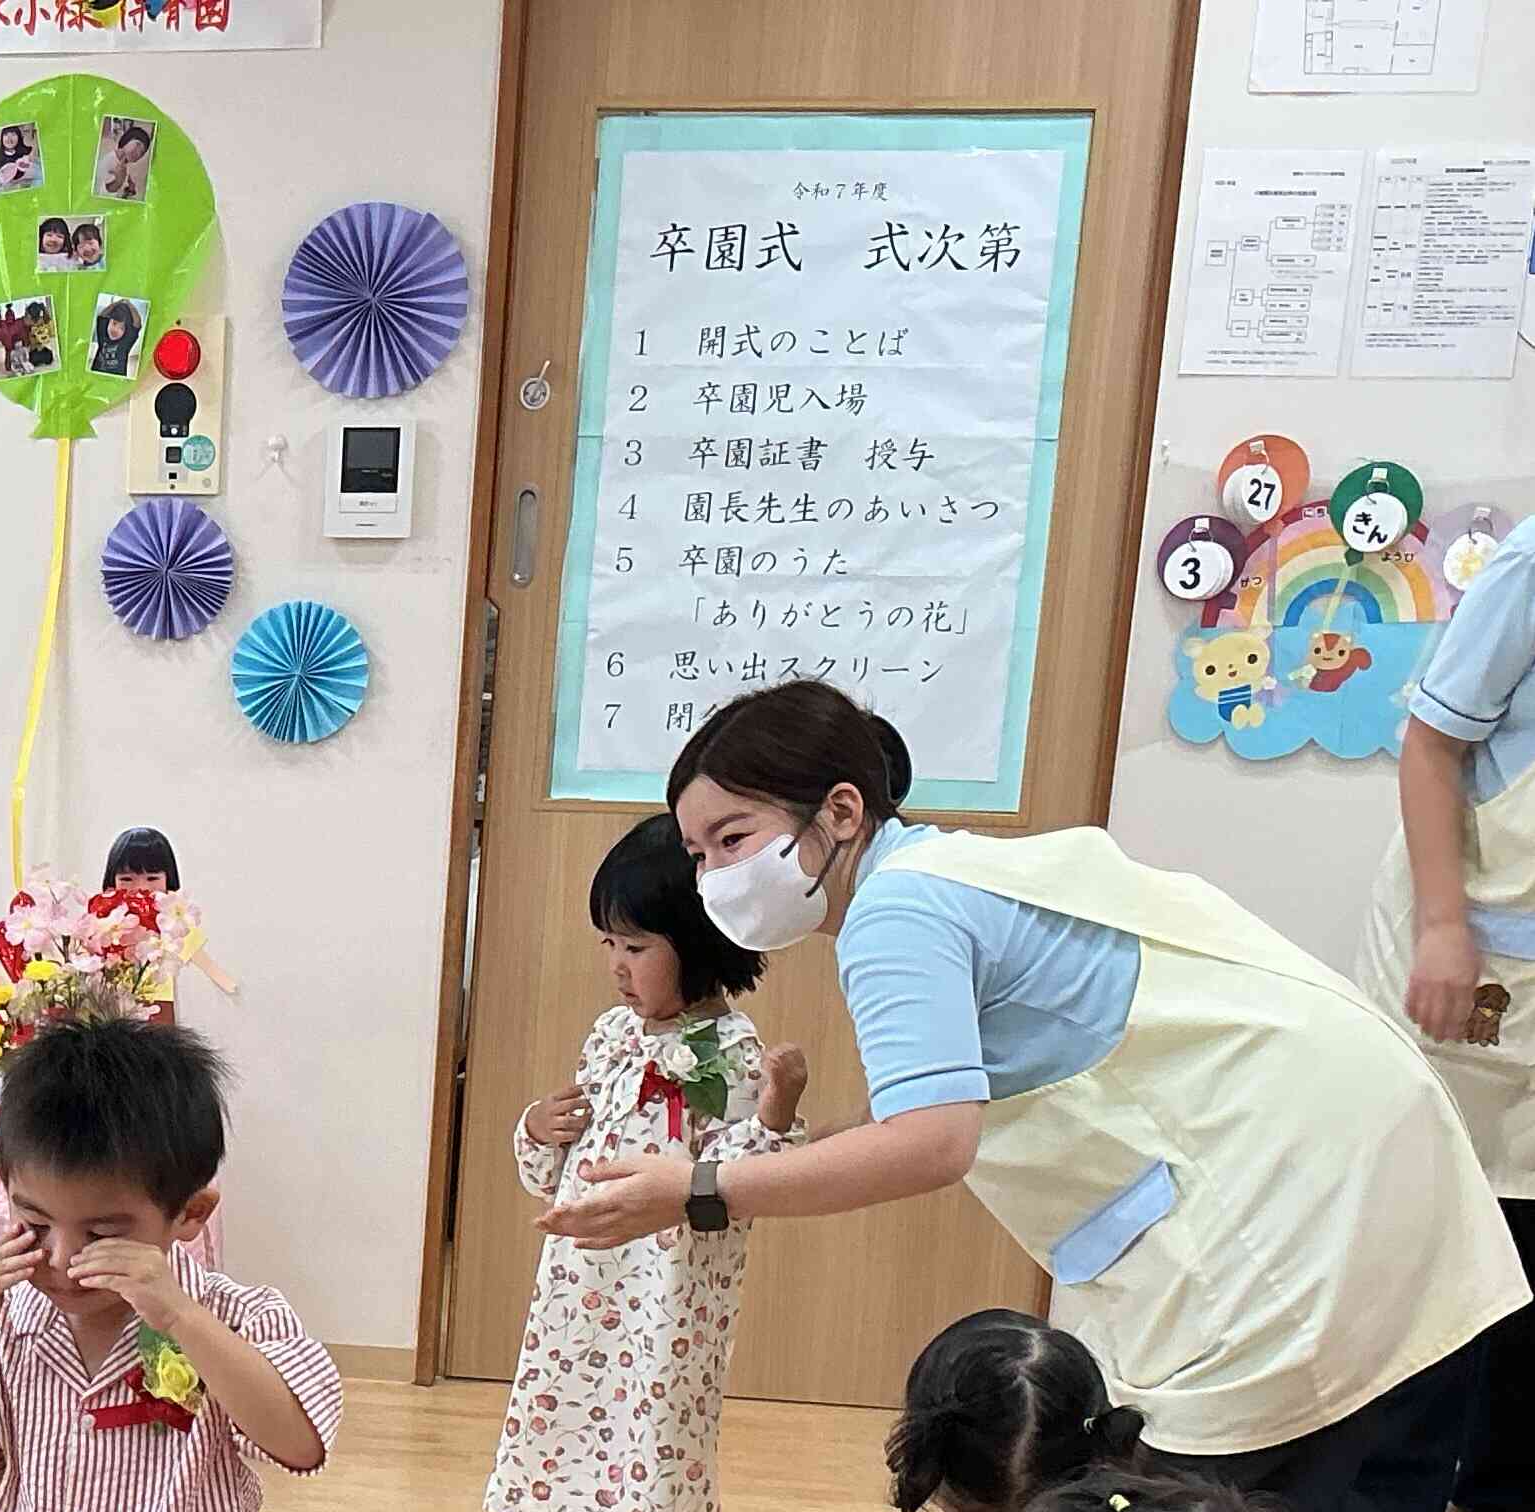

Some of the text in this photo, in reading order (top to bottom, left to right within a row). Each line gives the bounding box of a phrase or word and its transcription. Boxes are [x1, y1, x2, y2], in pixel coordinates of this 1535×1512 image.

[793, 181, 889, 201] 令和7年度
[649, 220, 1022, 273] 卒園式 式次第
[634, 323, 909, 359] 1 開式のことば
[628, 381, 868, 417] 2 卒園児入場
[623, 435, 936, 473] 3 卒園証書 授与
[617, 490, 1000, 525] 4 園長先生のあいさつ
[1247, 478, 1276, 511] 27
[1352, 511, 1388, 544] きん
[615, 543, 849, 578] 5 卒園のうた
[1178, 557, 1201, 590] 3
[693, 596, 969, 636] 「ありがとうの花」
[606, 650, 944, 683] 6 思い出スクリーン
[604, 703, 622, 730] 7
